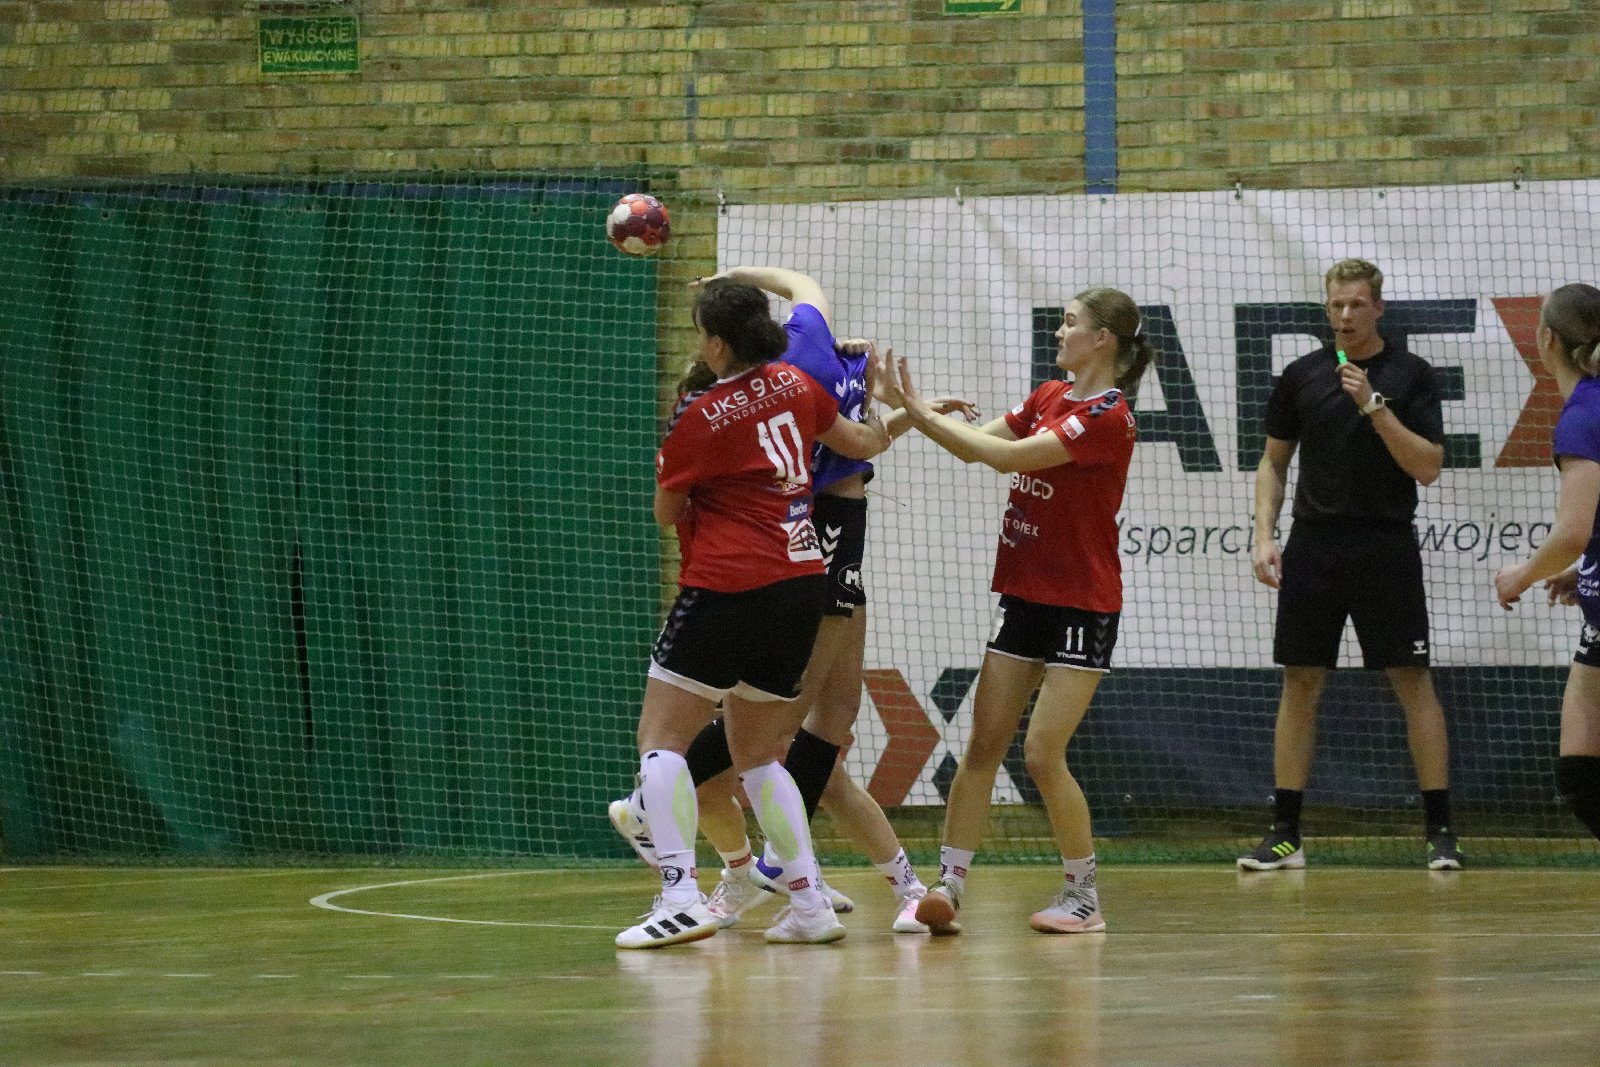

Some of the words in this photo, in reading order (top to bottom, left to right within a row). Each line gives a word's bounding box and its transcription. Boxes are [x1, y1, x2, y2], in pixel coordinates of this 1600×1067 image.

[263, 49, 356, 63] EWAKUACYJNE
[702, 390, 749, 420] UKS
[750, 378, 766, 398] 9
[768, 370, 801, 391] LCA
[711, 398, 778, 432] HANDBALL
[782, 385, 809, 400] TEAM
[756, 411, 809, 484] 10
[1118, 516, 1282, 565] sparci
[1066, 626, 1084, 652] 11
